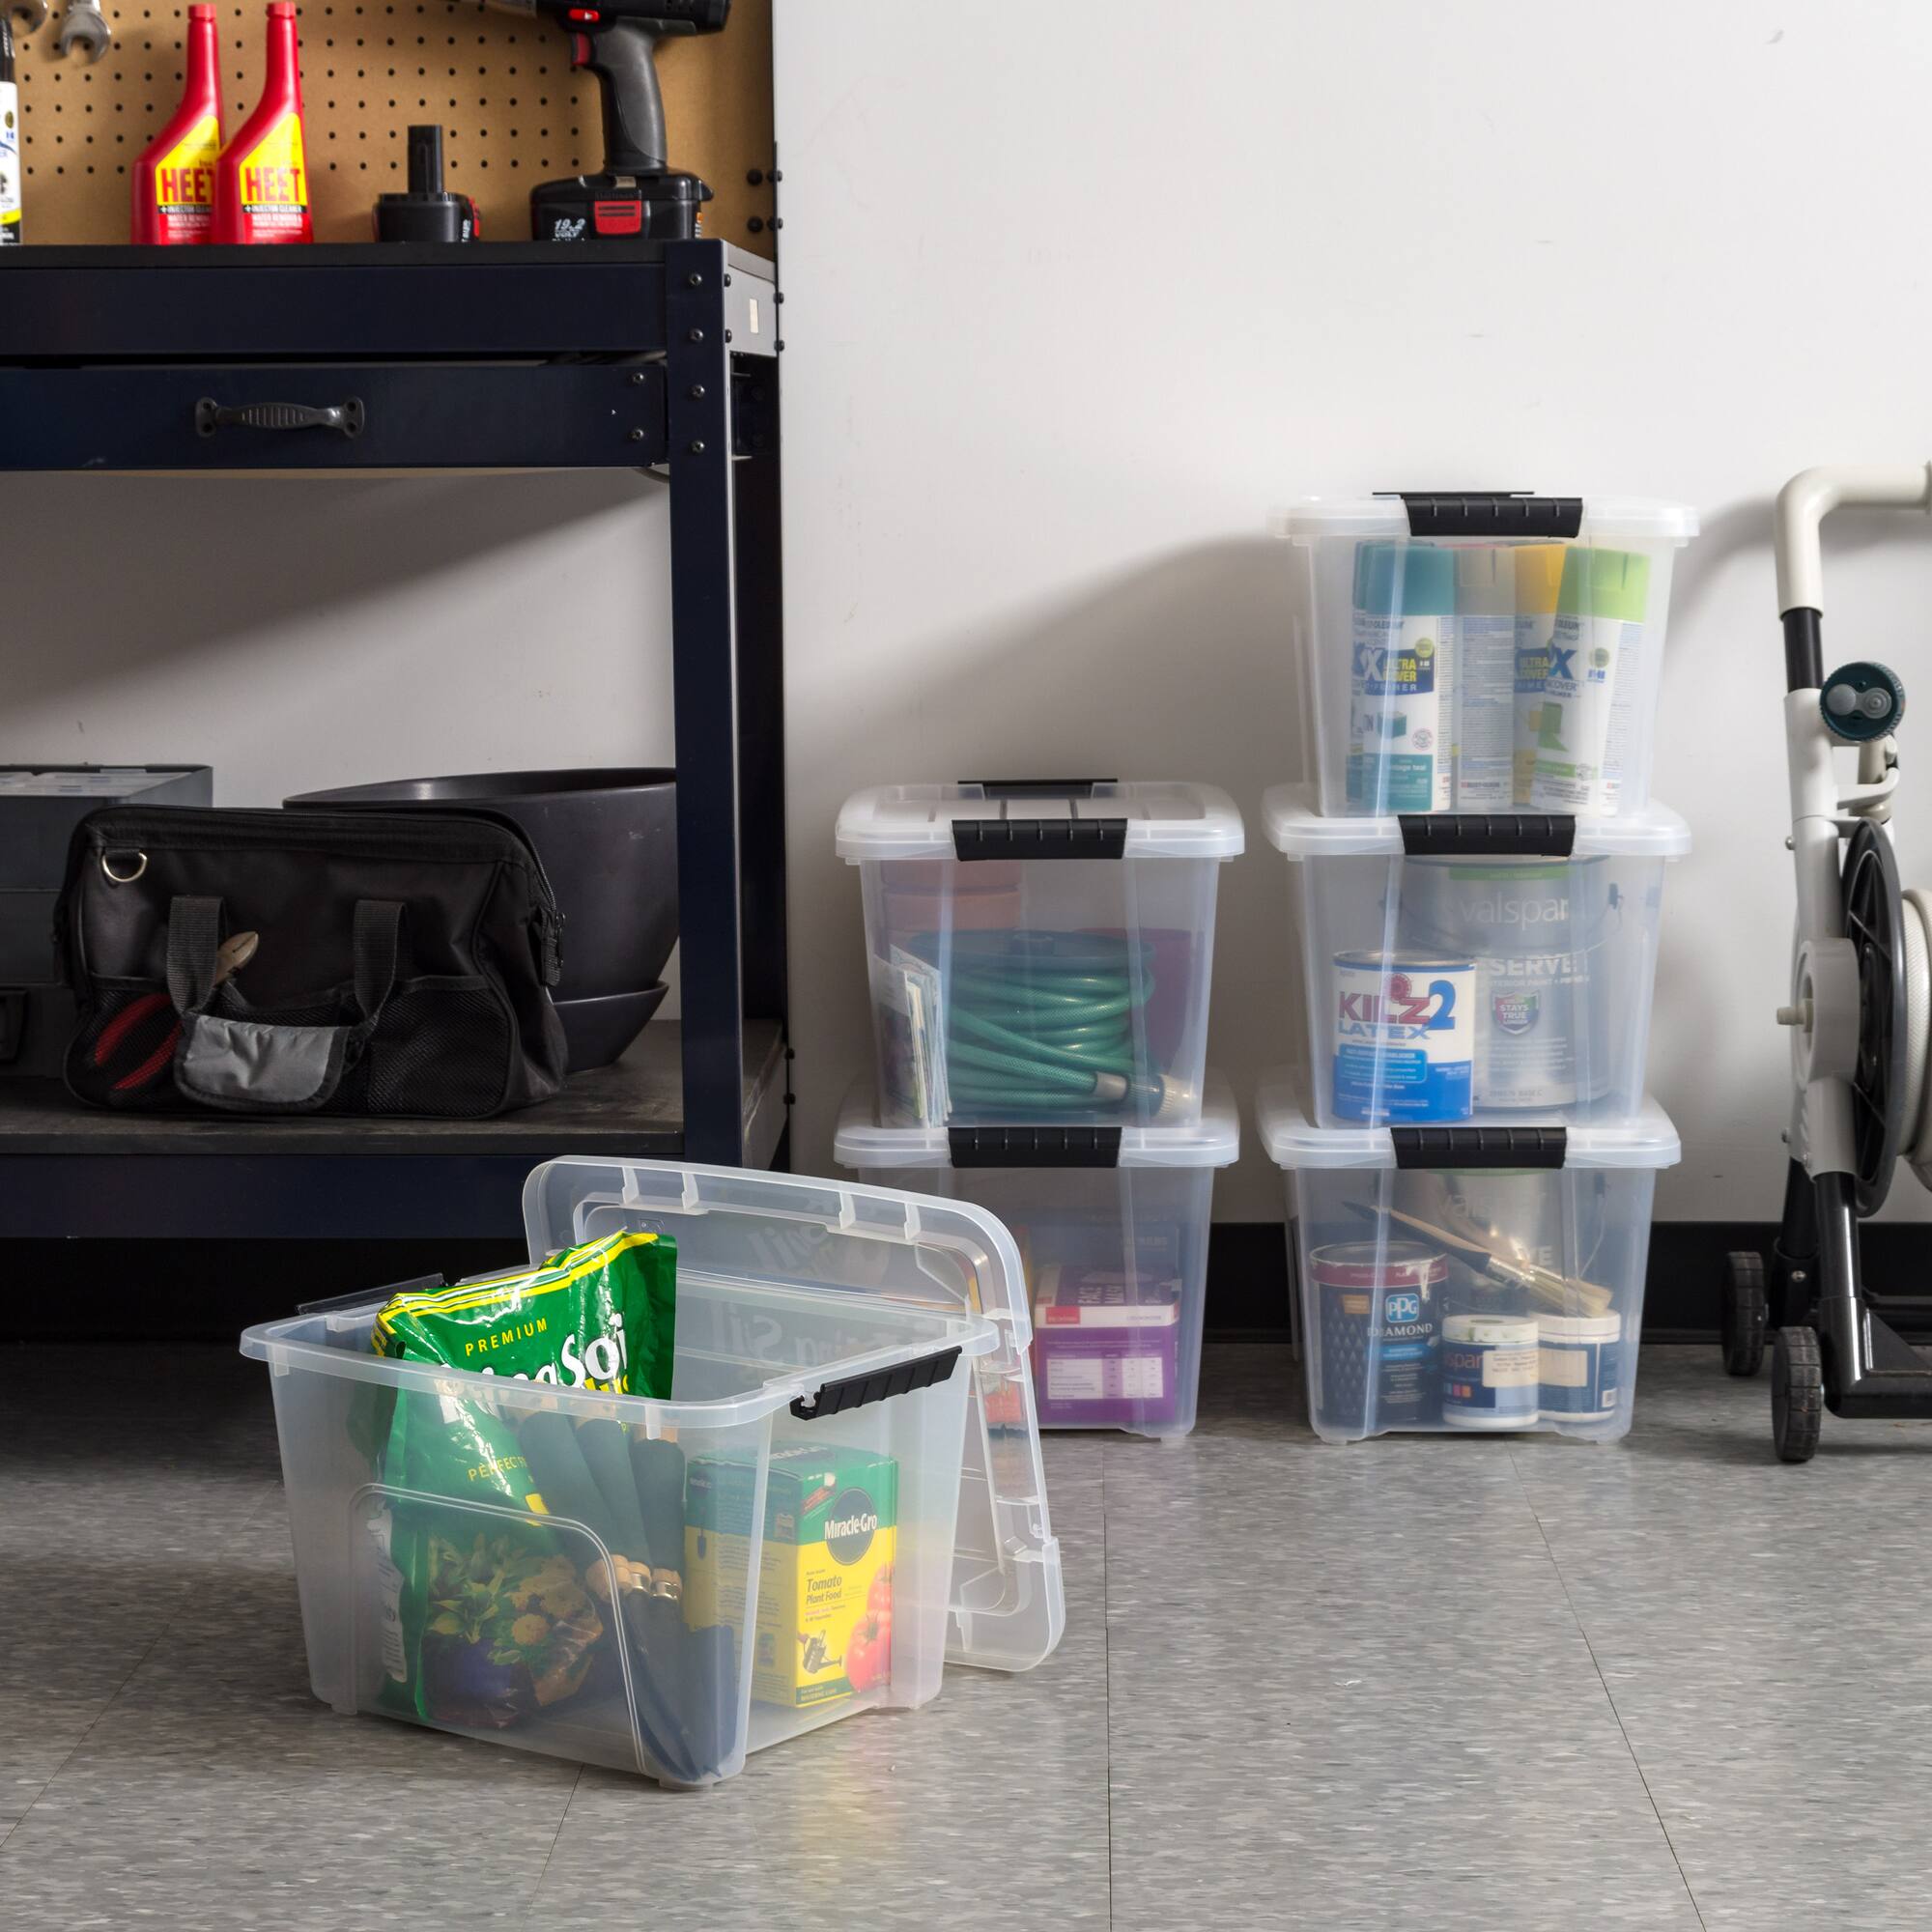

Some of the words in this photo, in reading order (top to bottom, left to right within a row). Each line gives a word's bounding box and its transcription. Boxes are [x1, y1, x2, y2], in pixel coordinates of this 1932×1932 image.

[245, 167, 300, 203] HEET
[554, 218, 586, 231] 19.2
[1462, 891, 1569, 931] valspar
[1491, 953, 1578, 976] SERVE
[1499, 1004, 1530, 1012] STAYS
[1502, 1011, 1527, 1020] TRUE
[1338, 1019, 1431, 1040] LATEX
[1388, 1297, 1418, 1320] PPG
[465, 1317, 549, 1357] PREMIUM
[1367, 1322, 1434, 1338] DIAMOND
[1444, 1352, 1483, 1372] spar
[824, 1512, 878, 1541] Miracle-Gro
[807, 1574, 842, 1593] Tomato
[806, 1592, 825, 1605] Plant
[825, 1587, 842, 1602] Food
